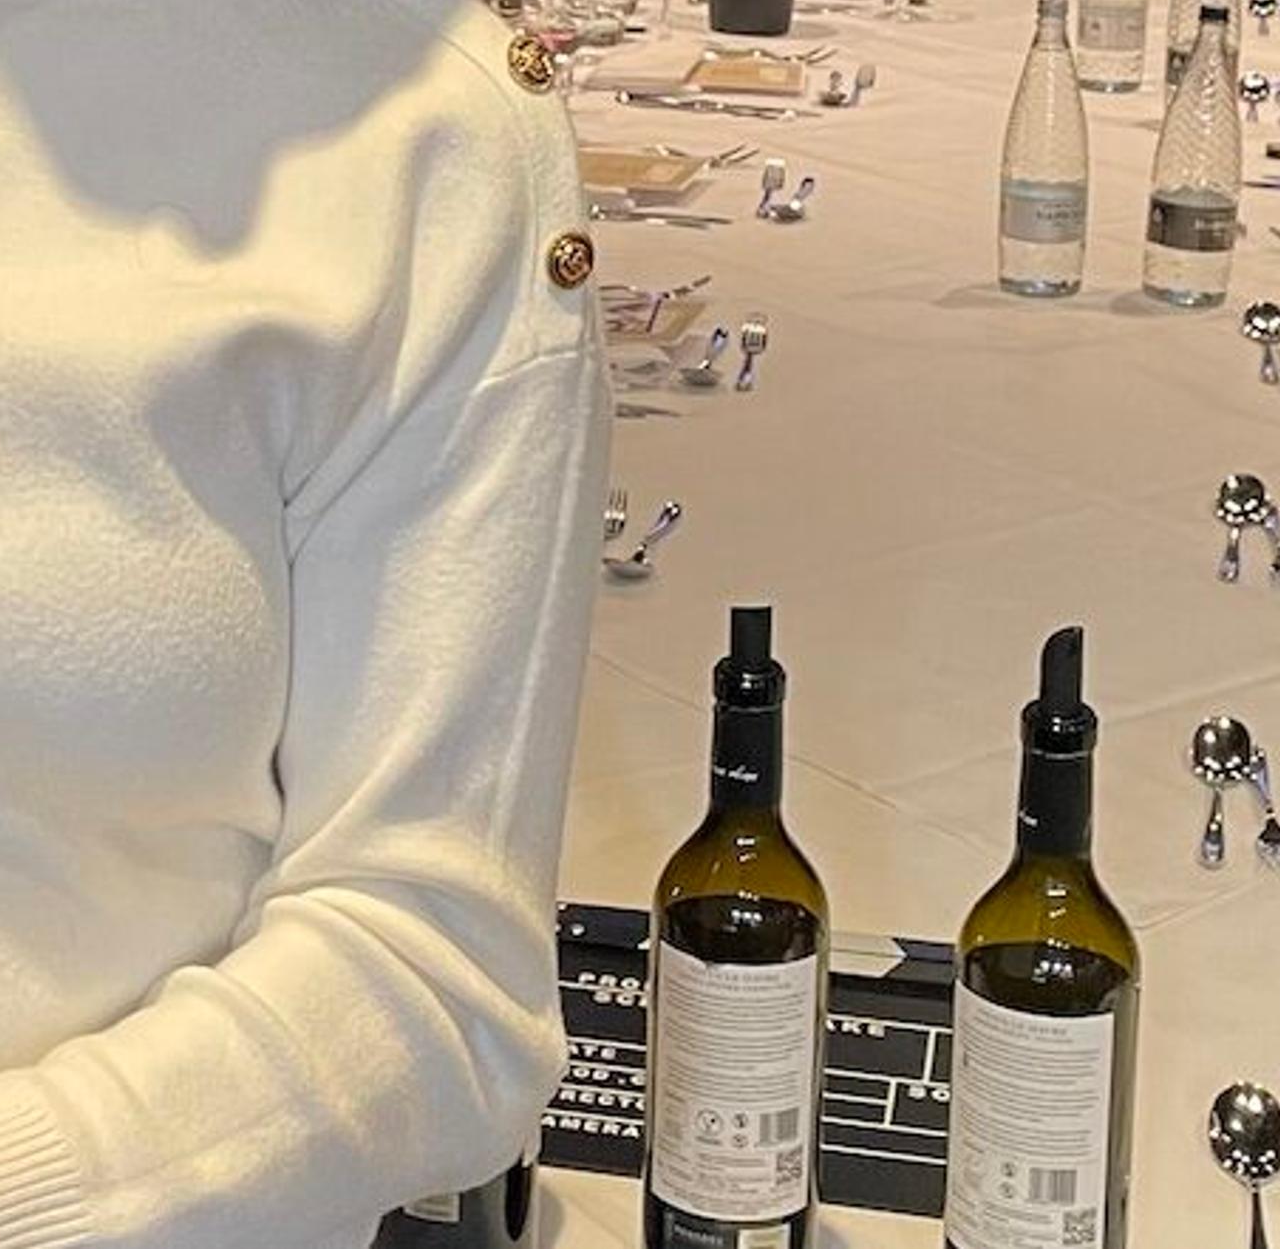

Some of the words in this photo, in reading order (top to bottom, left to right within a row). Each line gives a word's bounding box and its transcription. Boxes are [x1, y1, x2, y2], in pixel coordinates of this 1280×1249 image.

[578, 972, 648, 991] PRO
[825, 1019, 885, 1039] AKE
[570, 1044, 616, 1060] ATE
[907, 1084, 951, 1103] SO
[540, 1115, 640, 1139] AMERA
